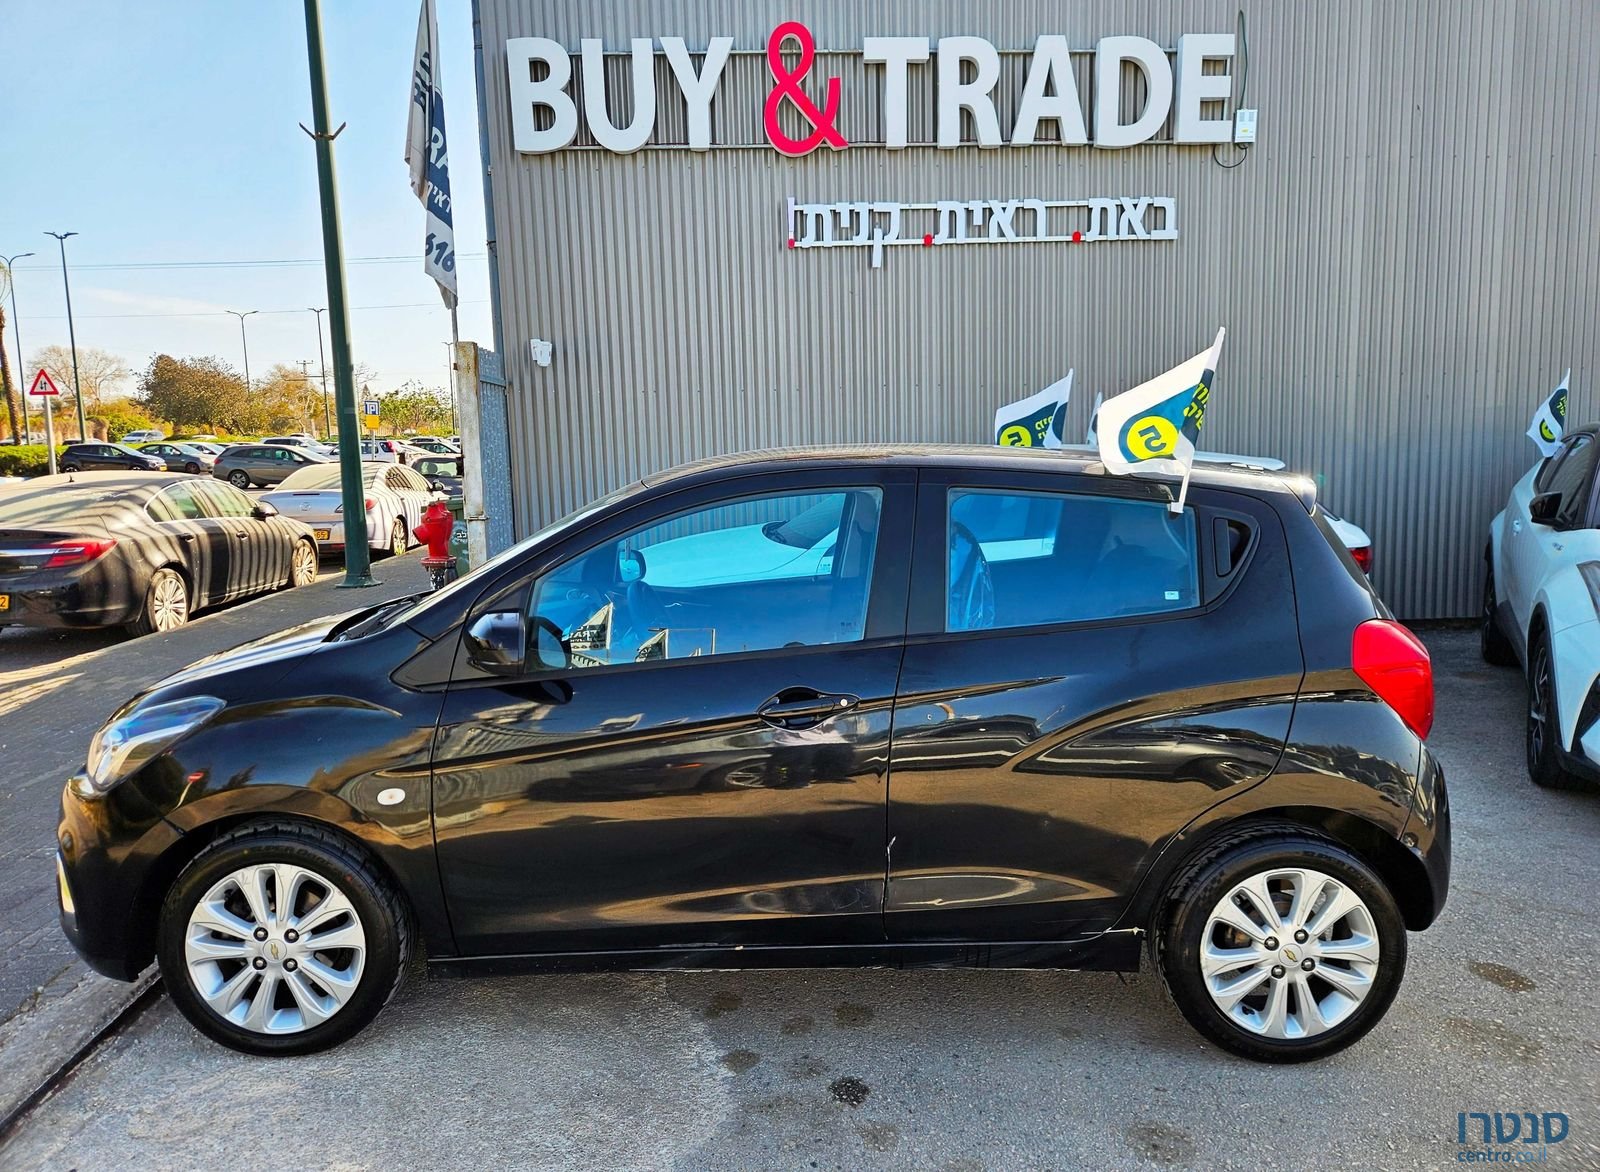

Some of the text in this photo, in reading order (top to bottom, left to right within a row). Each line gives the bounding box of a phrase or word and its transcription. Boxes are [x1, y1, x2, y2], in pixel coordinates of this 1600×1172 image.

[506, 36, 734, 155] BUY
[764, 21, 849, 157] &
[863, 34, 1235, 150] TRADE
[787, 196, 1178, 268] באת. ראית. קנית!
